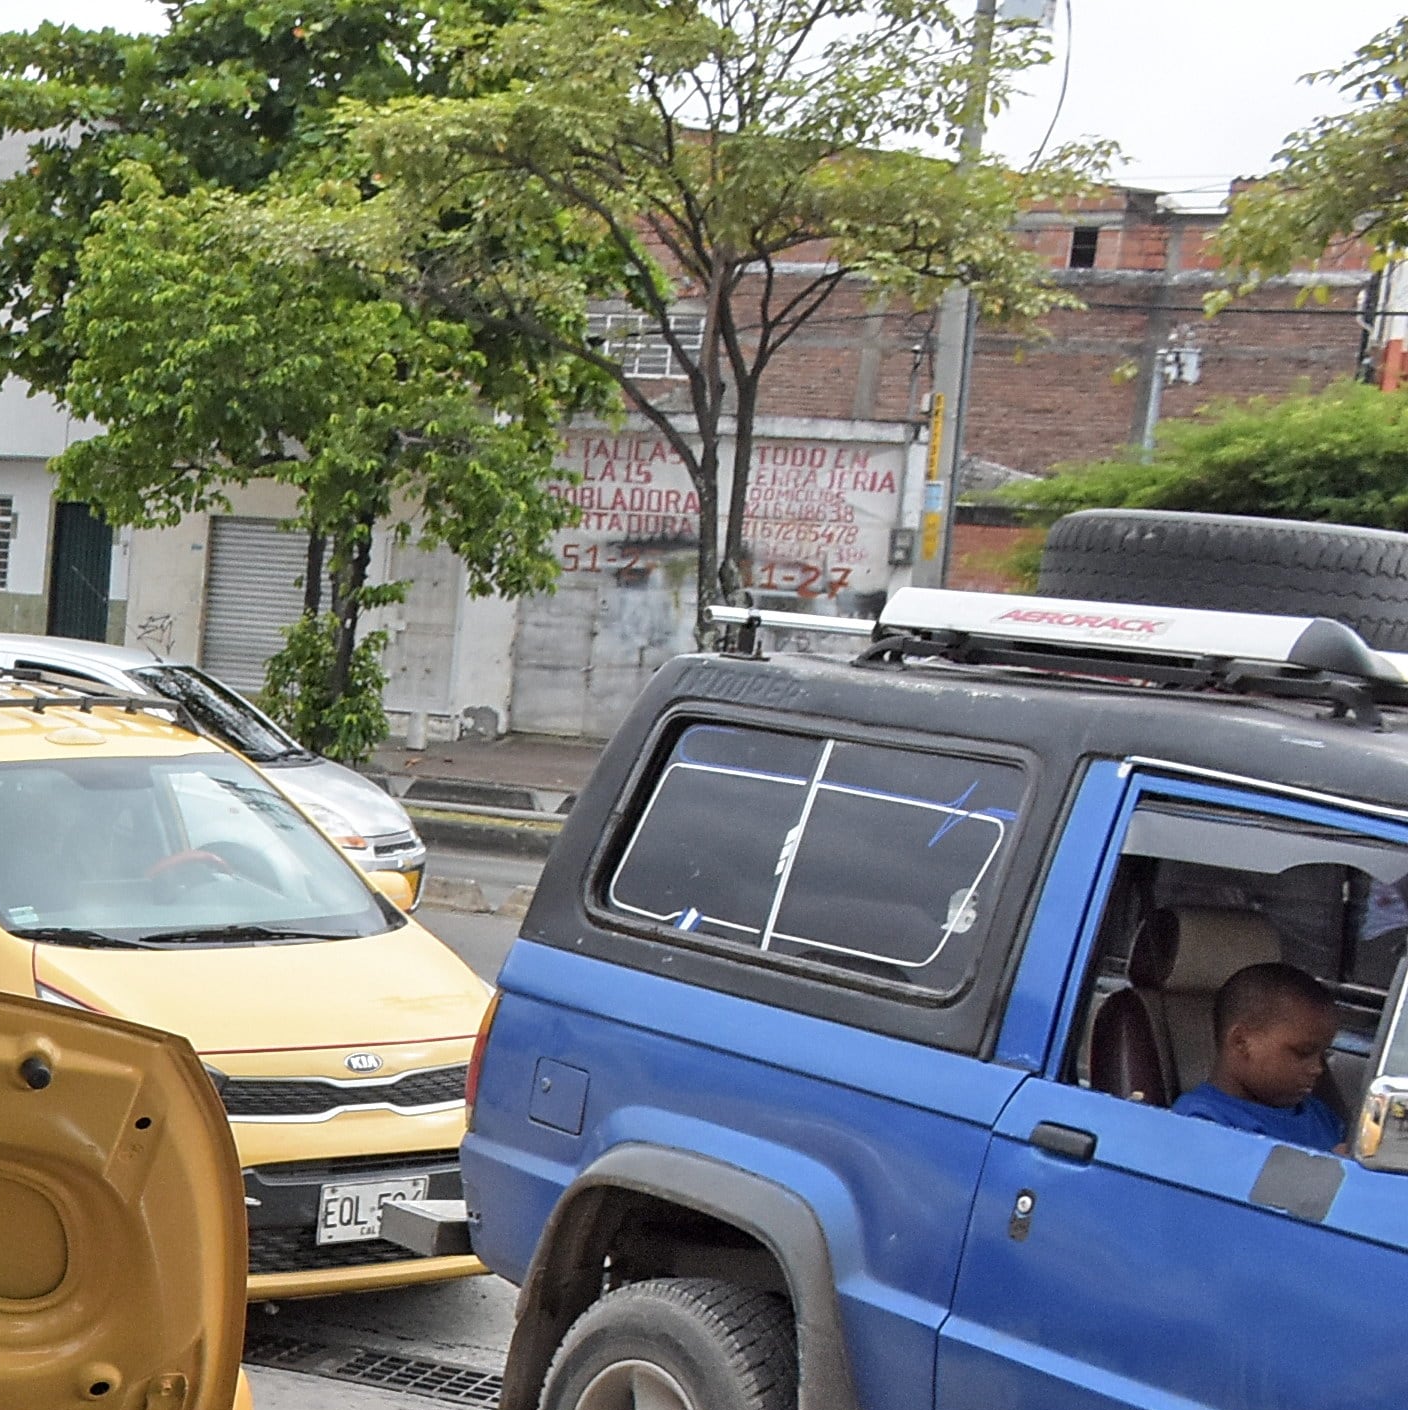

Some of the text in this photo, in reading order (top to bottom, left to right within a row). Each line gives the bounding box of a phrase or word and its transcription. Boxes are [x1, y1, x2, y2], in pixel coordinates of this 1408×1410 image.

[559, 437, 685, 464] ETALICAS
[756, 445, 870, 469] TODO EN
[584, 459, 653, 484] LA 15
[997, 607, 1164, 634] AERORACK
[350, 1056, 378, 1069] KIA
[323, 1193, 369, 1229] EQL
[360, 1225, 378, 1236] CAL
